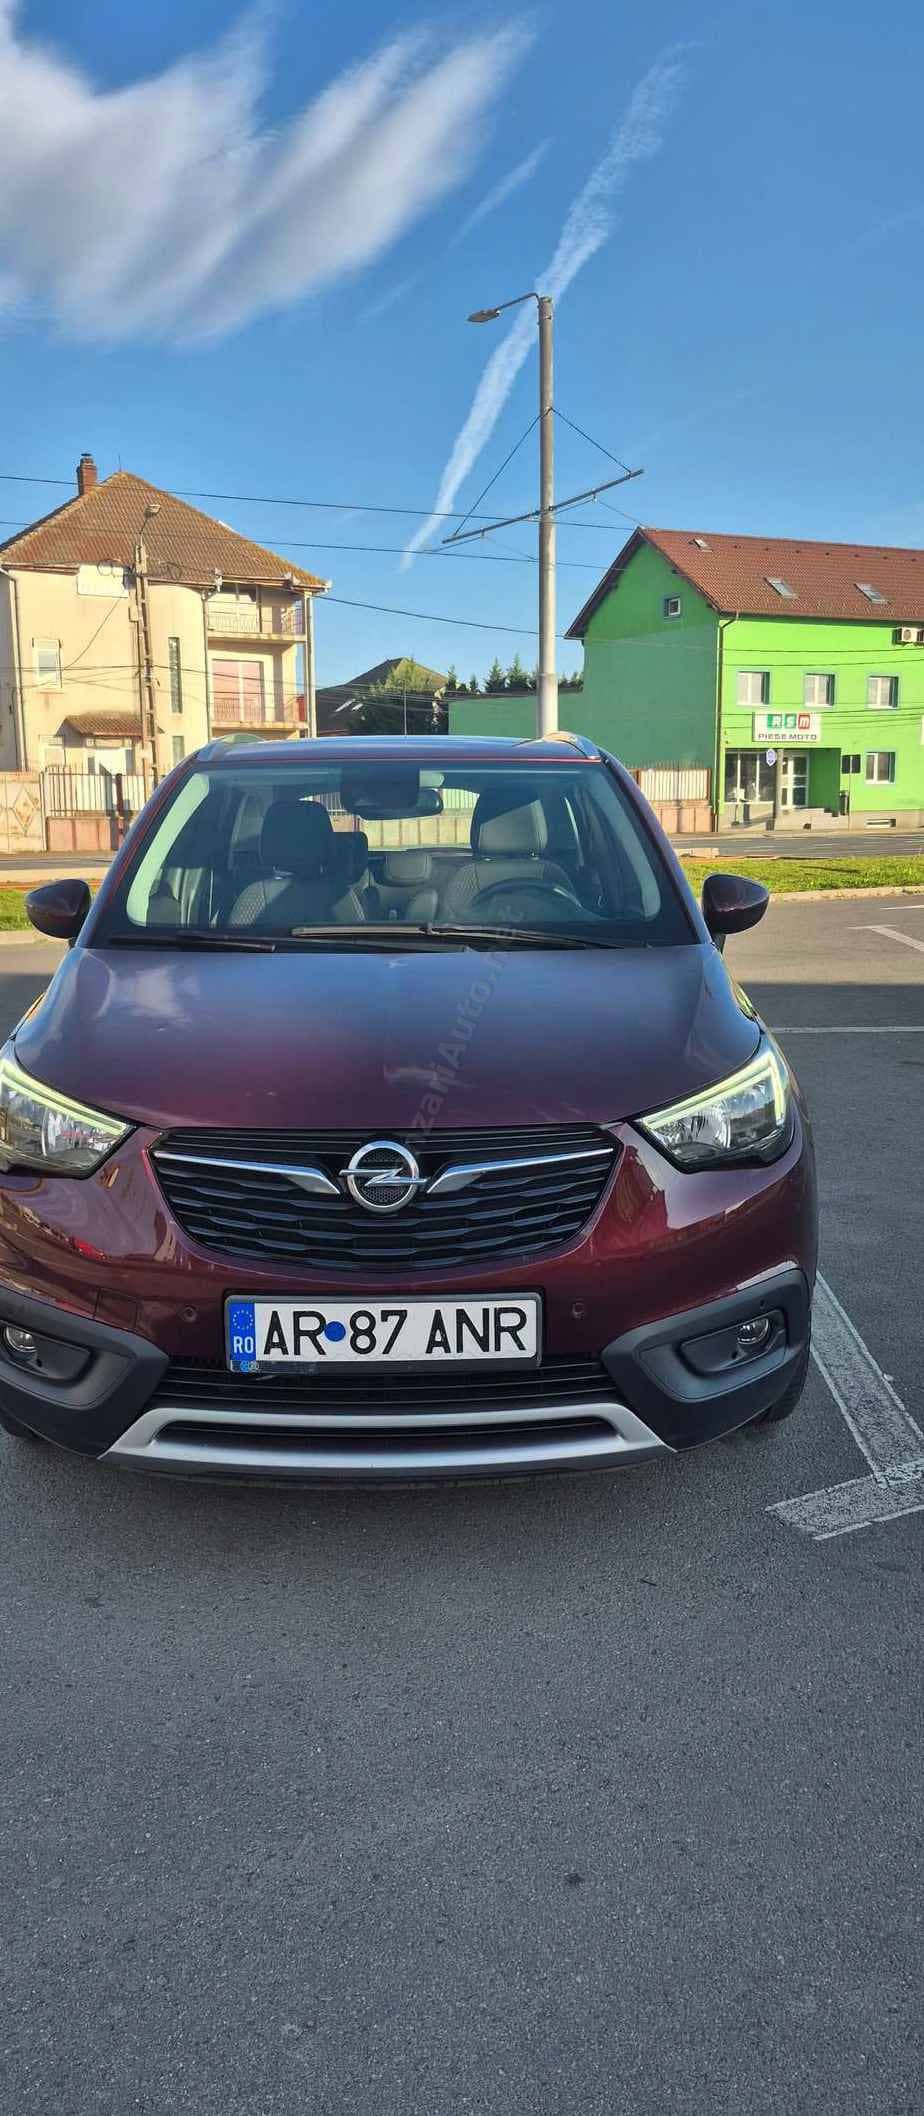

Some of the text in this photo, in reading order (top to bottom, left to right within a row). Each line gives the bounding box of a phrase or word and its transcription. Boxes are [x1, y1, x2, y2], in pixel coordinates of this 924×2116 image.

[233, 1336, 254, 1354] RO
[263, 1307, 528, 1356] AR 87 ANR
